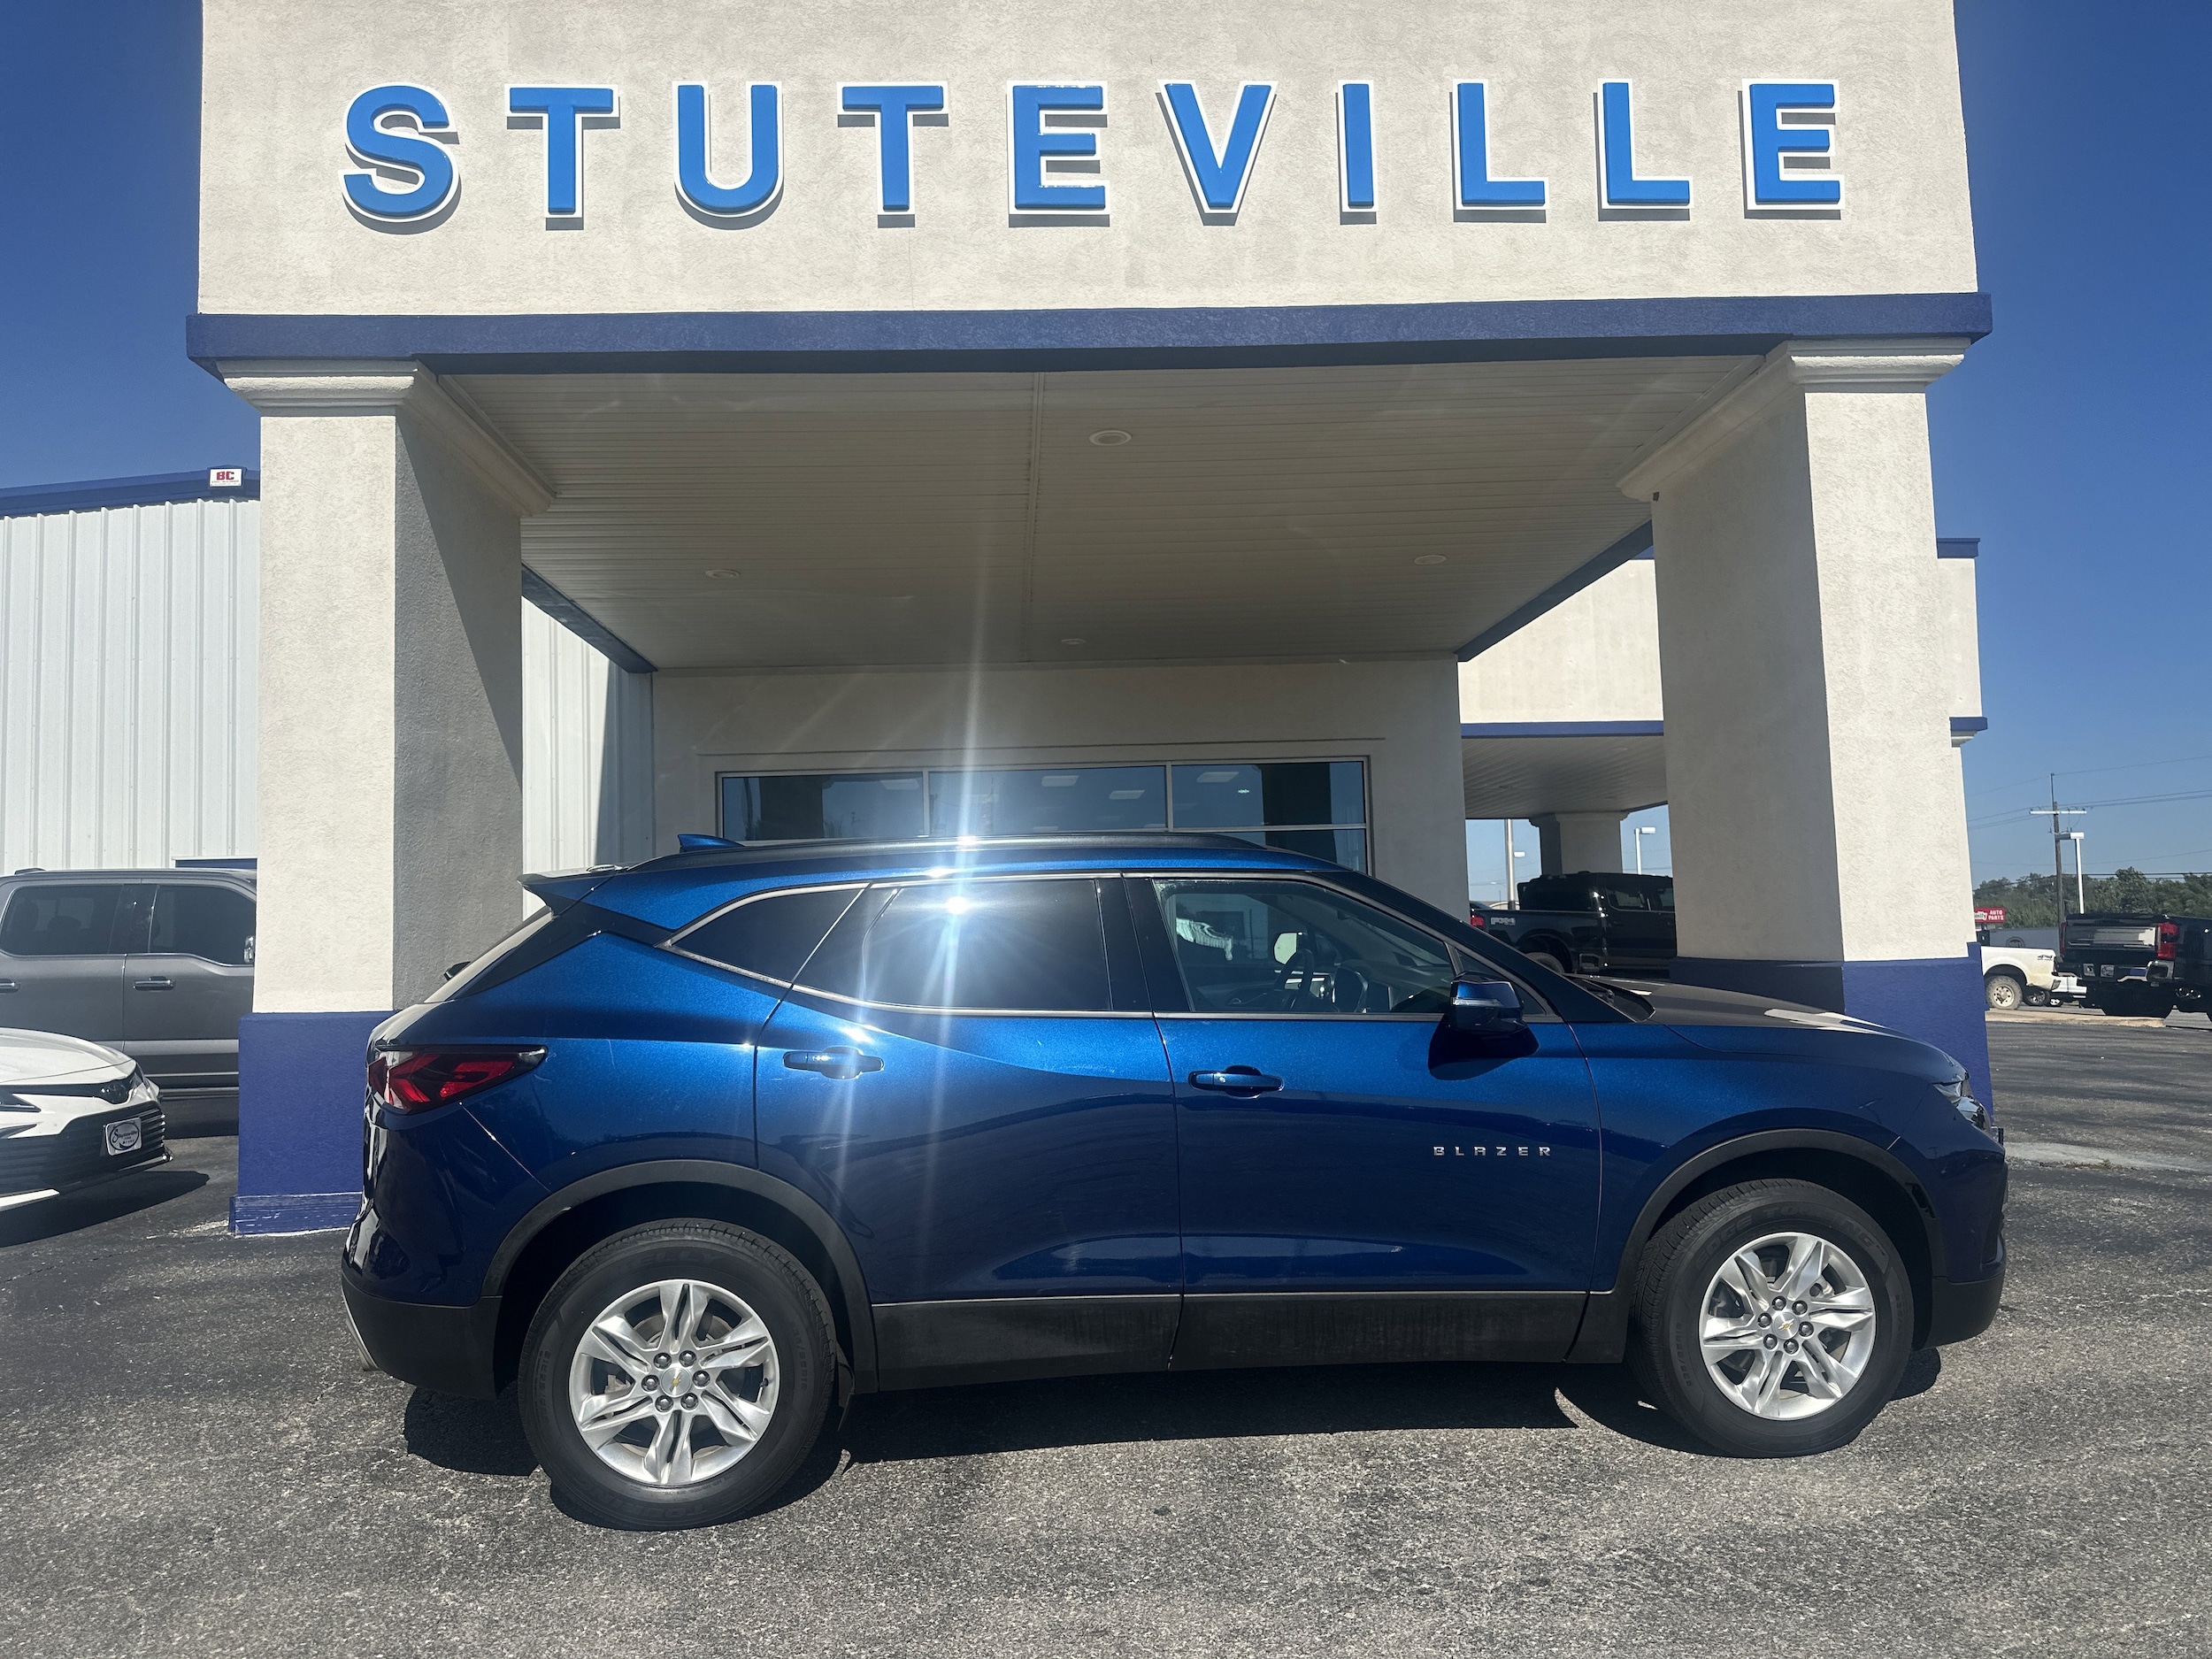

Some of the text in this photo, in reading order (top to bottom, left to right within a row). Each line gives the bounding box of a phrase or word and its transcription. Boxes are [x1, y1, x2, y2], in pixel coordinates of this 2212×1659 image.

[338, 78, 1845, 222] STUTEVILLE
[216, 471, 234, 480] BC
[1432, 1146, 1551, 1156] BLAZER
